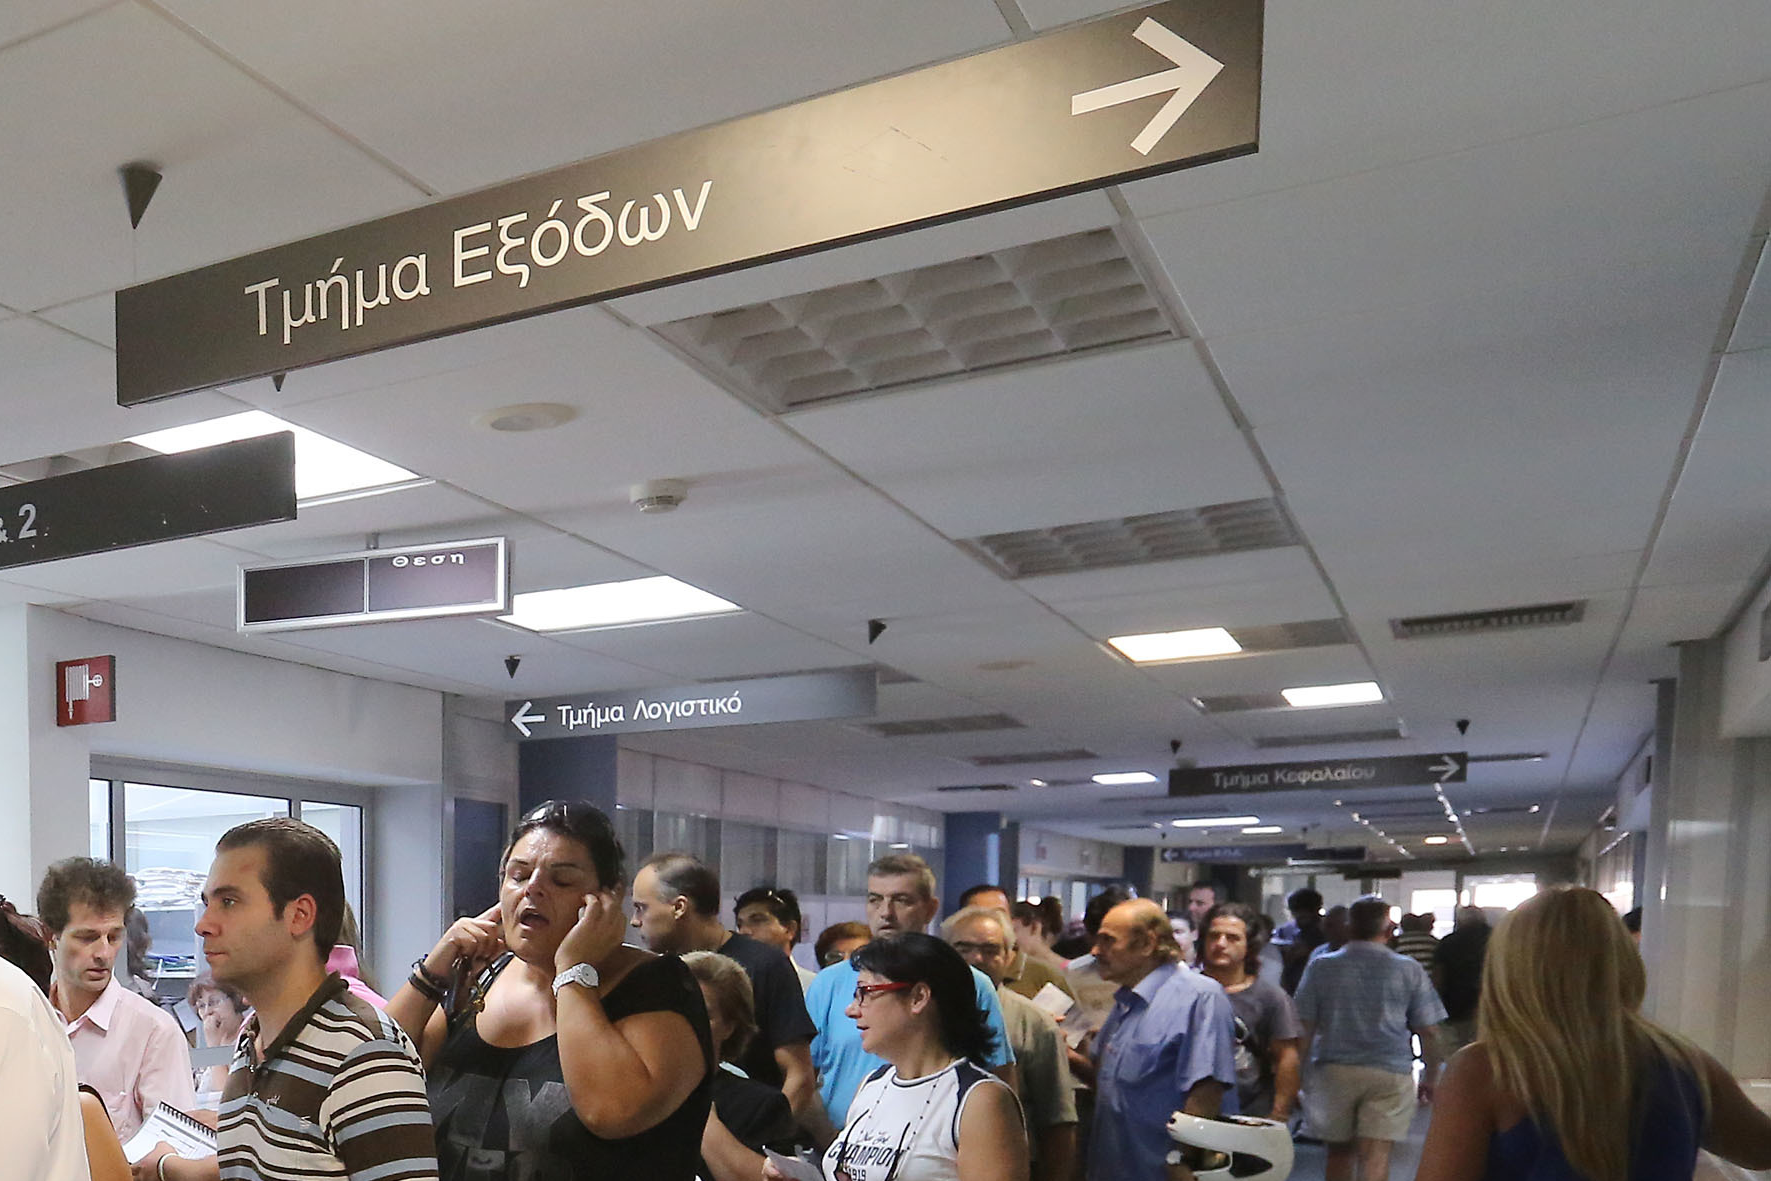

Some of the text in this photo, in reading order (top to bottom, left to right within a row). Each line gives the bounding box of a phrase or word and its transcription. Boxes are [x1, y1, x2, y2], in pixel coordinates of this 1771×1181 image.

[244, 179, 715, 345] Τμήμα Εξόδων
[18, 503, 38, 539] 2
[392, 552, 466, 568] Θεση
[556, 690, 742, 730] Τμήμα Λογιστικό
[1213, 764, 1376, 788] Τμήμα Κεφαλαίου
